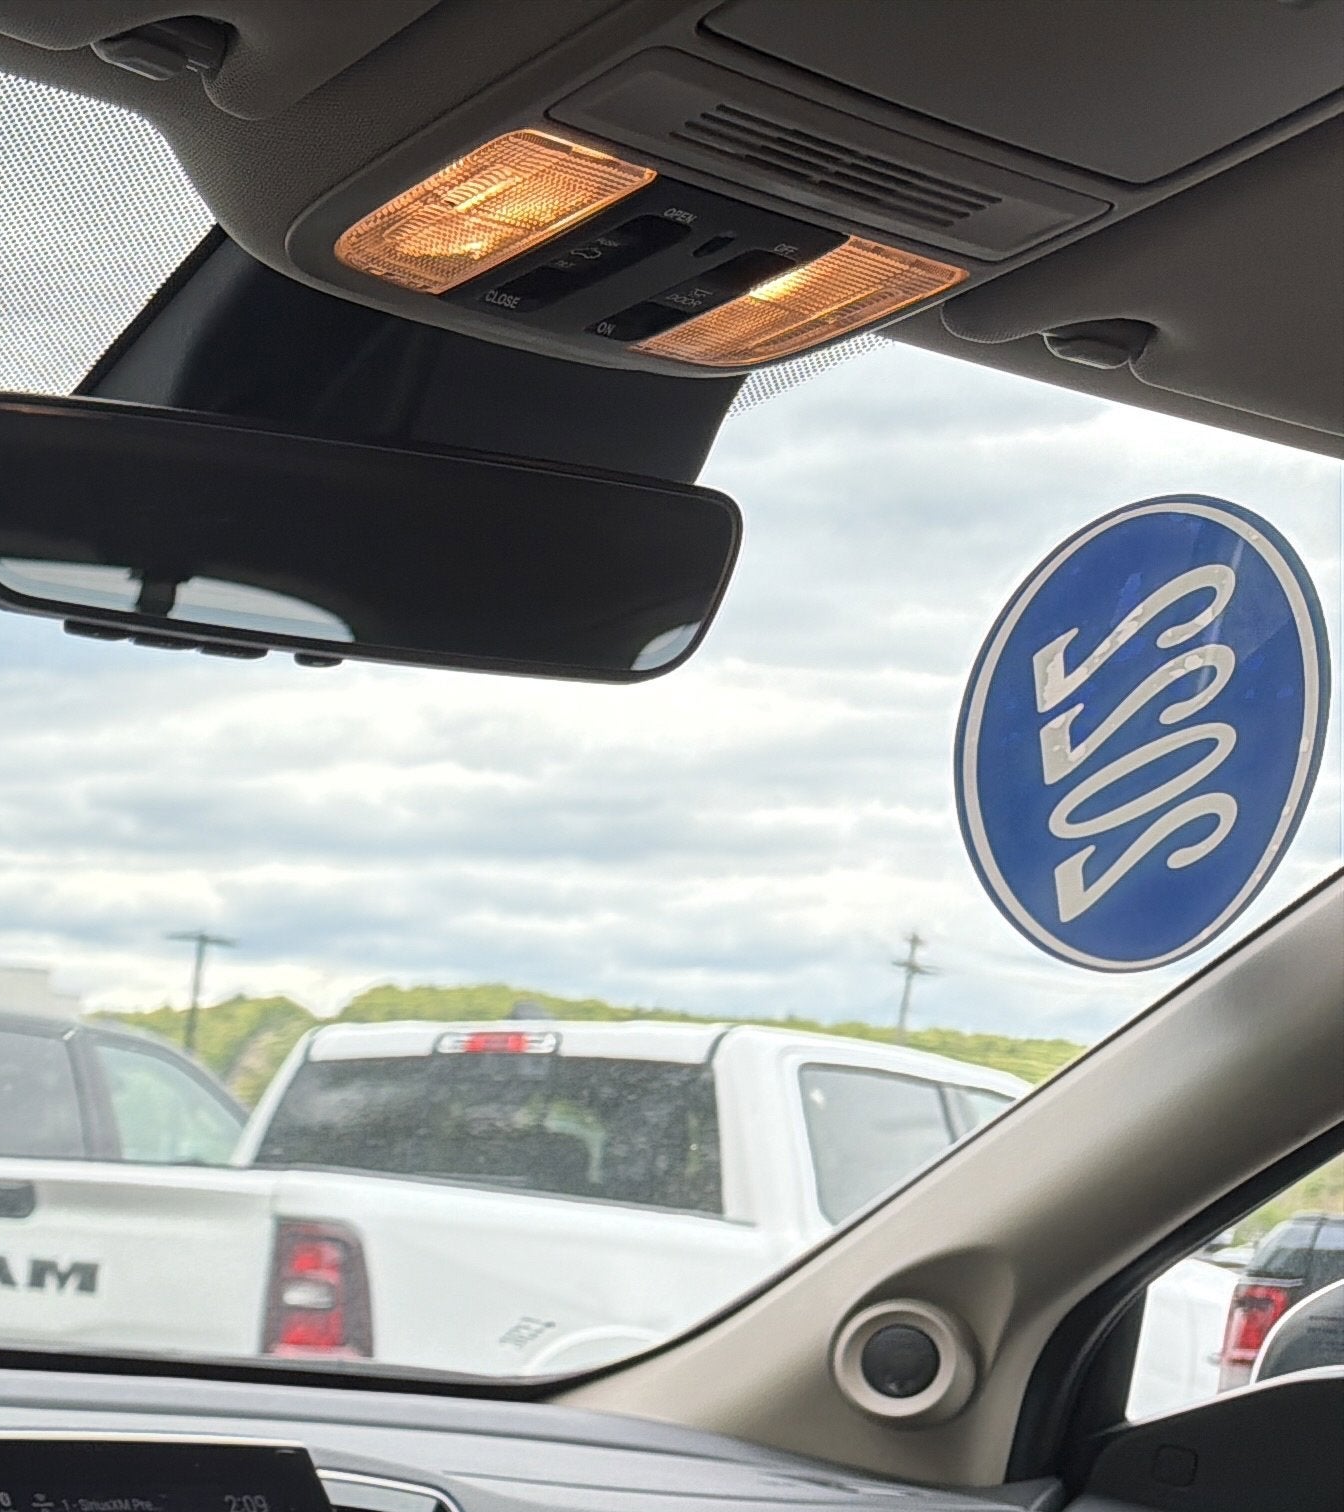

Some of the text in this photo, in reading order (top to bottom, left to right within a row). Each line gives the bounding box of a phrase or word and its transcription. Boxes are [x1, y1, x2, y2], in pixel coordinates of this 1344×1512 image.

[663, 207, 698, 225] OPEN
[484, 290, 521, 311] CLOSE
[596, 320, 617, 338] ON
